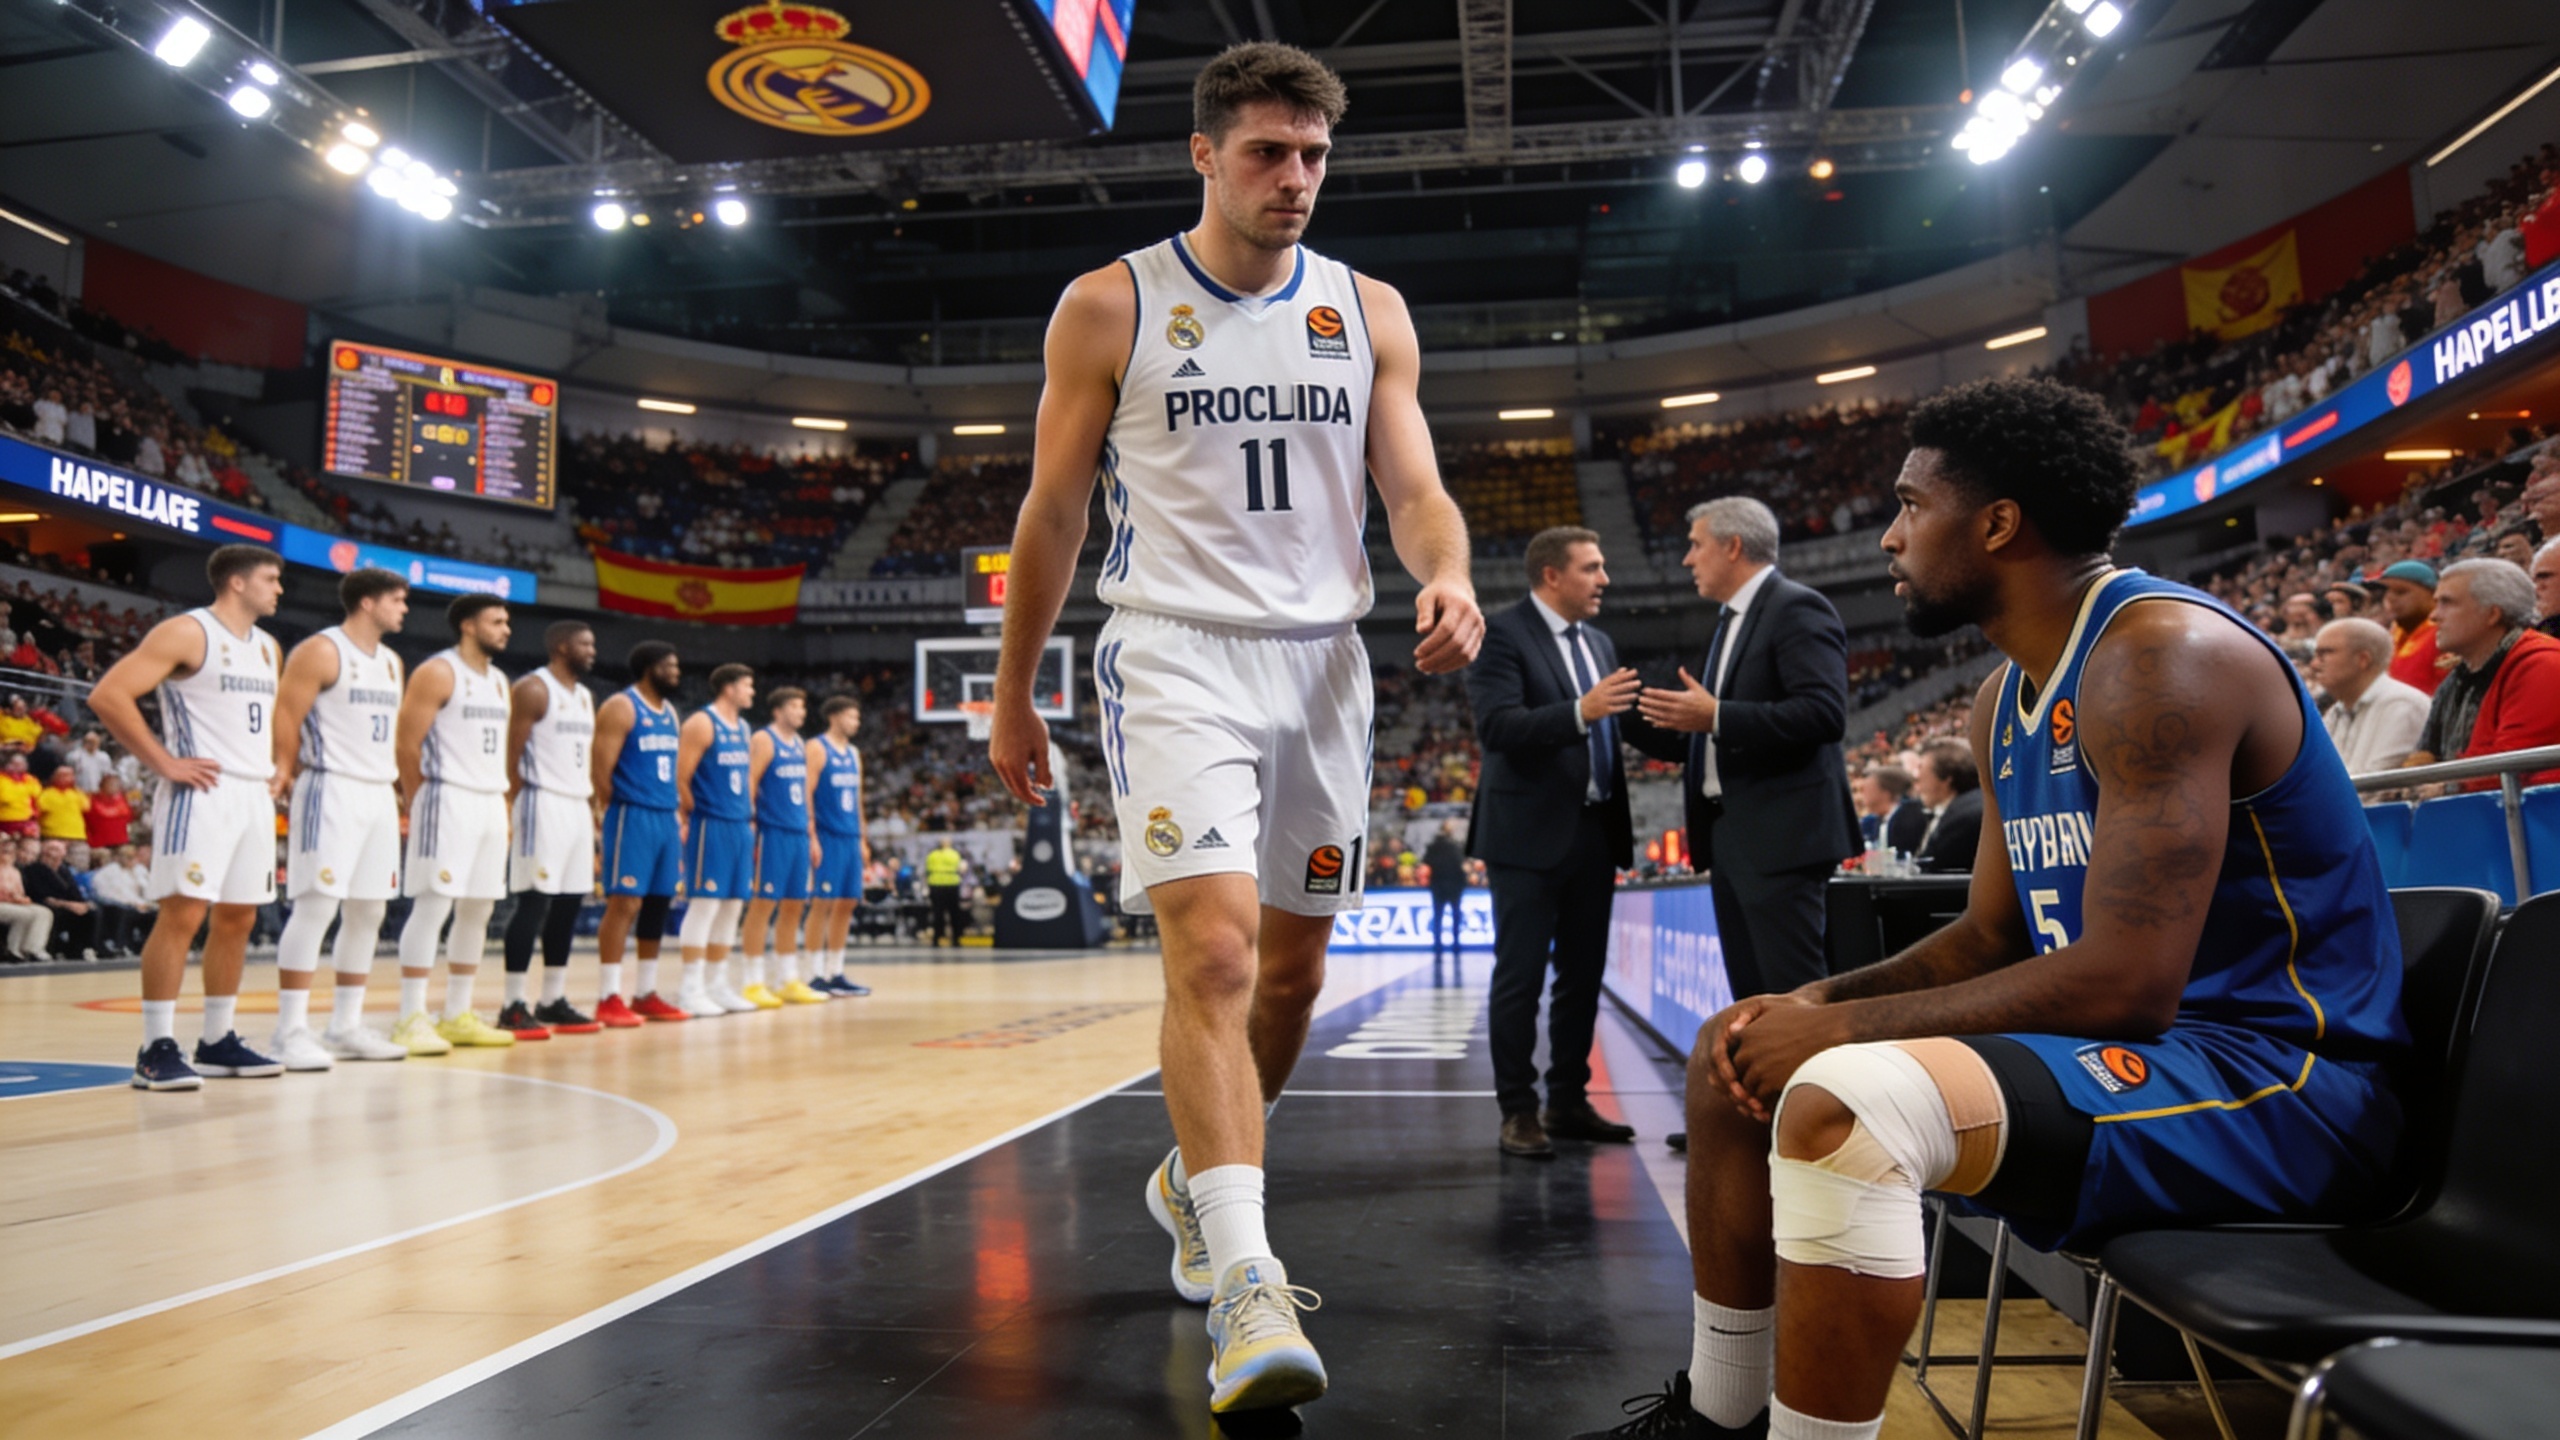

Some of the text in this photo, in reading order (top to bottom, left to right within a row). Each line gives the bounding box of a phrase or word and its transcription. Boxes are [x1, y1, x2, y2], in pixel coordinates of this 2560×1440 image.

[1240, 438, 1292, 511] 11
[249, 702, 262, 734] 9
[2029, 889, 2069, 955] 5
